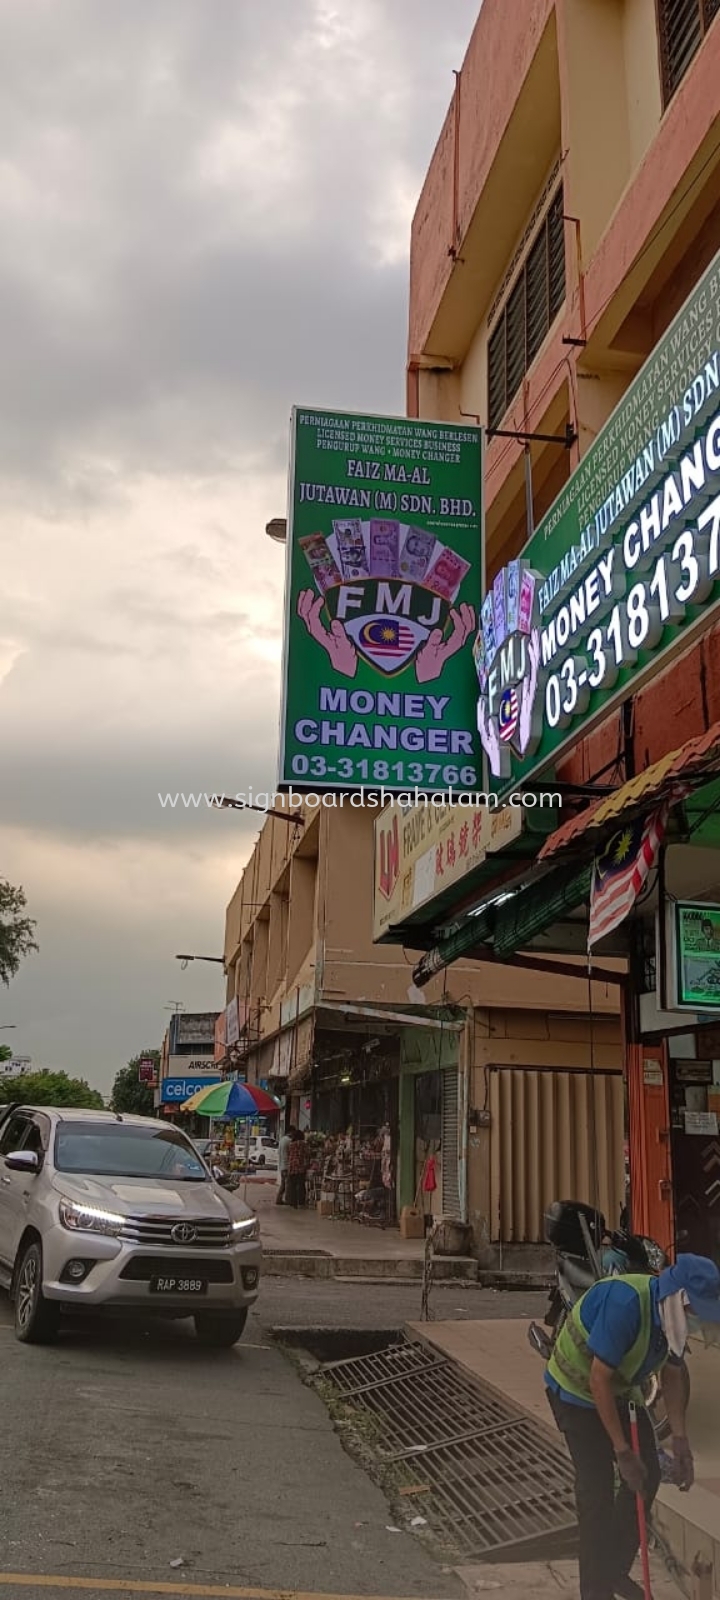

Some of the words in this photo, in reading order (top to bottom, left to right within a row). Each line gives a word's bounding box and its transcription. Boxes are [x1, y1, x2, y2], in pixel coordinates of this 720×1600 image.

[544, 461, 591, 540] PERNIAGAAN
[593, 347, 670, 471] PERKHIDMATAN
[670, 290, 707, 353] WANG
[577, 451, 619, 513] LICENSED
[620, 394, 655, 455] MONEY
[657, 309, 713, 401] SERVICES
[300, 415, 350, 429] PERNIAGAAN
[352, 421, 413, 436] PERKHIDMATAN
[414, 428, 437, 439] WANG
[439, 430, 478, 442] BERLESEN
[317, 429, 356, 441] LICENSED
[357, 434, 385, 444] MONEY
[386, 436, 422, 448] SERVICES
[424, 440, 461, 452] BUSINESS
[578, 457, 626, 531] PENGURUP
[627, 411, 659, 463] WANG
[669, 333, 712, 407] MONEY
[317, 440, 361, 454] PENGURUP
[362, 445, 385, 455] WANG
[393, 449, 421, 460] MONEY
[422, 452, 461, 463] CHANGER
[347, 459, 380, 480] FAIZ
[383, 463, 431, 485] MA-AL
[300, 483, 371, 508] JUTAWAN
[374, 490, 397, 511] (M)
[401, 494, 436, 514] SDN.
[440, 498, 476, 517] BHD.
[539, 571, 559, 614] FAIZ
[560, 522, 595, 585] MA-AL
[594, 439, 655, 546] JUTAWAN
[655, 406, 680, 462] (M)
[540, 548, 615, 667] MONEY
[319, 687, 450, 720] MONEY
[294, 719, 475, 755] CHANGER
[291, 754, 477, 786] 03-31813766
[157, 1278, 176, 1291] RAP
